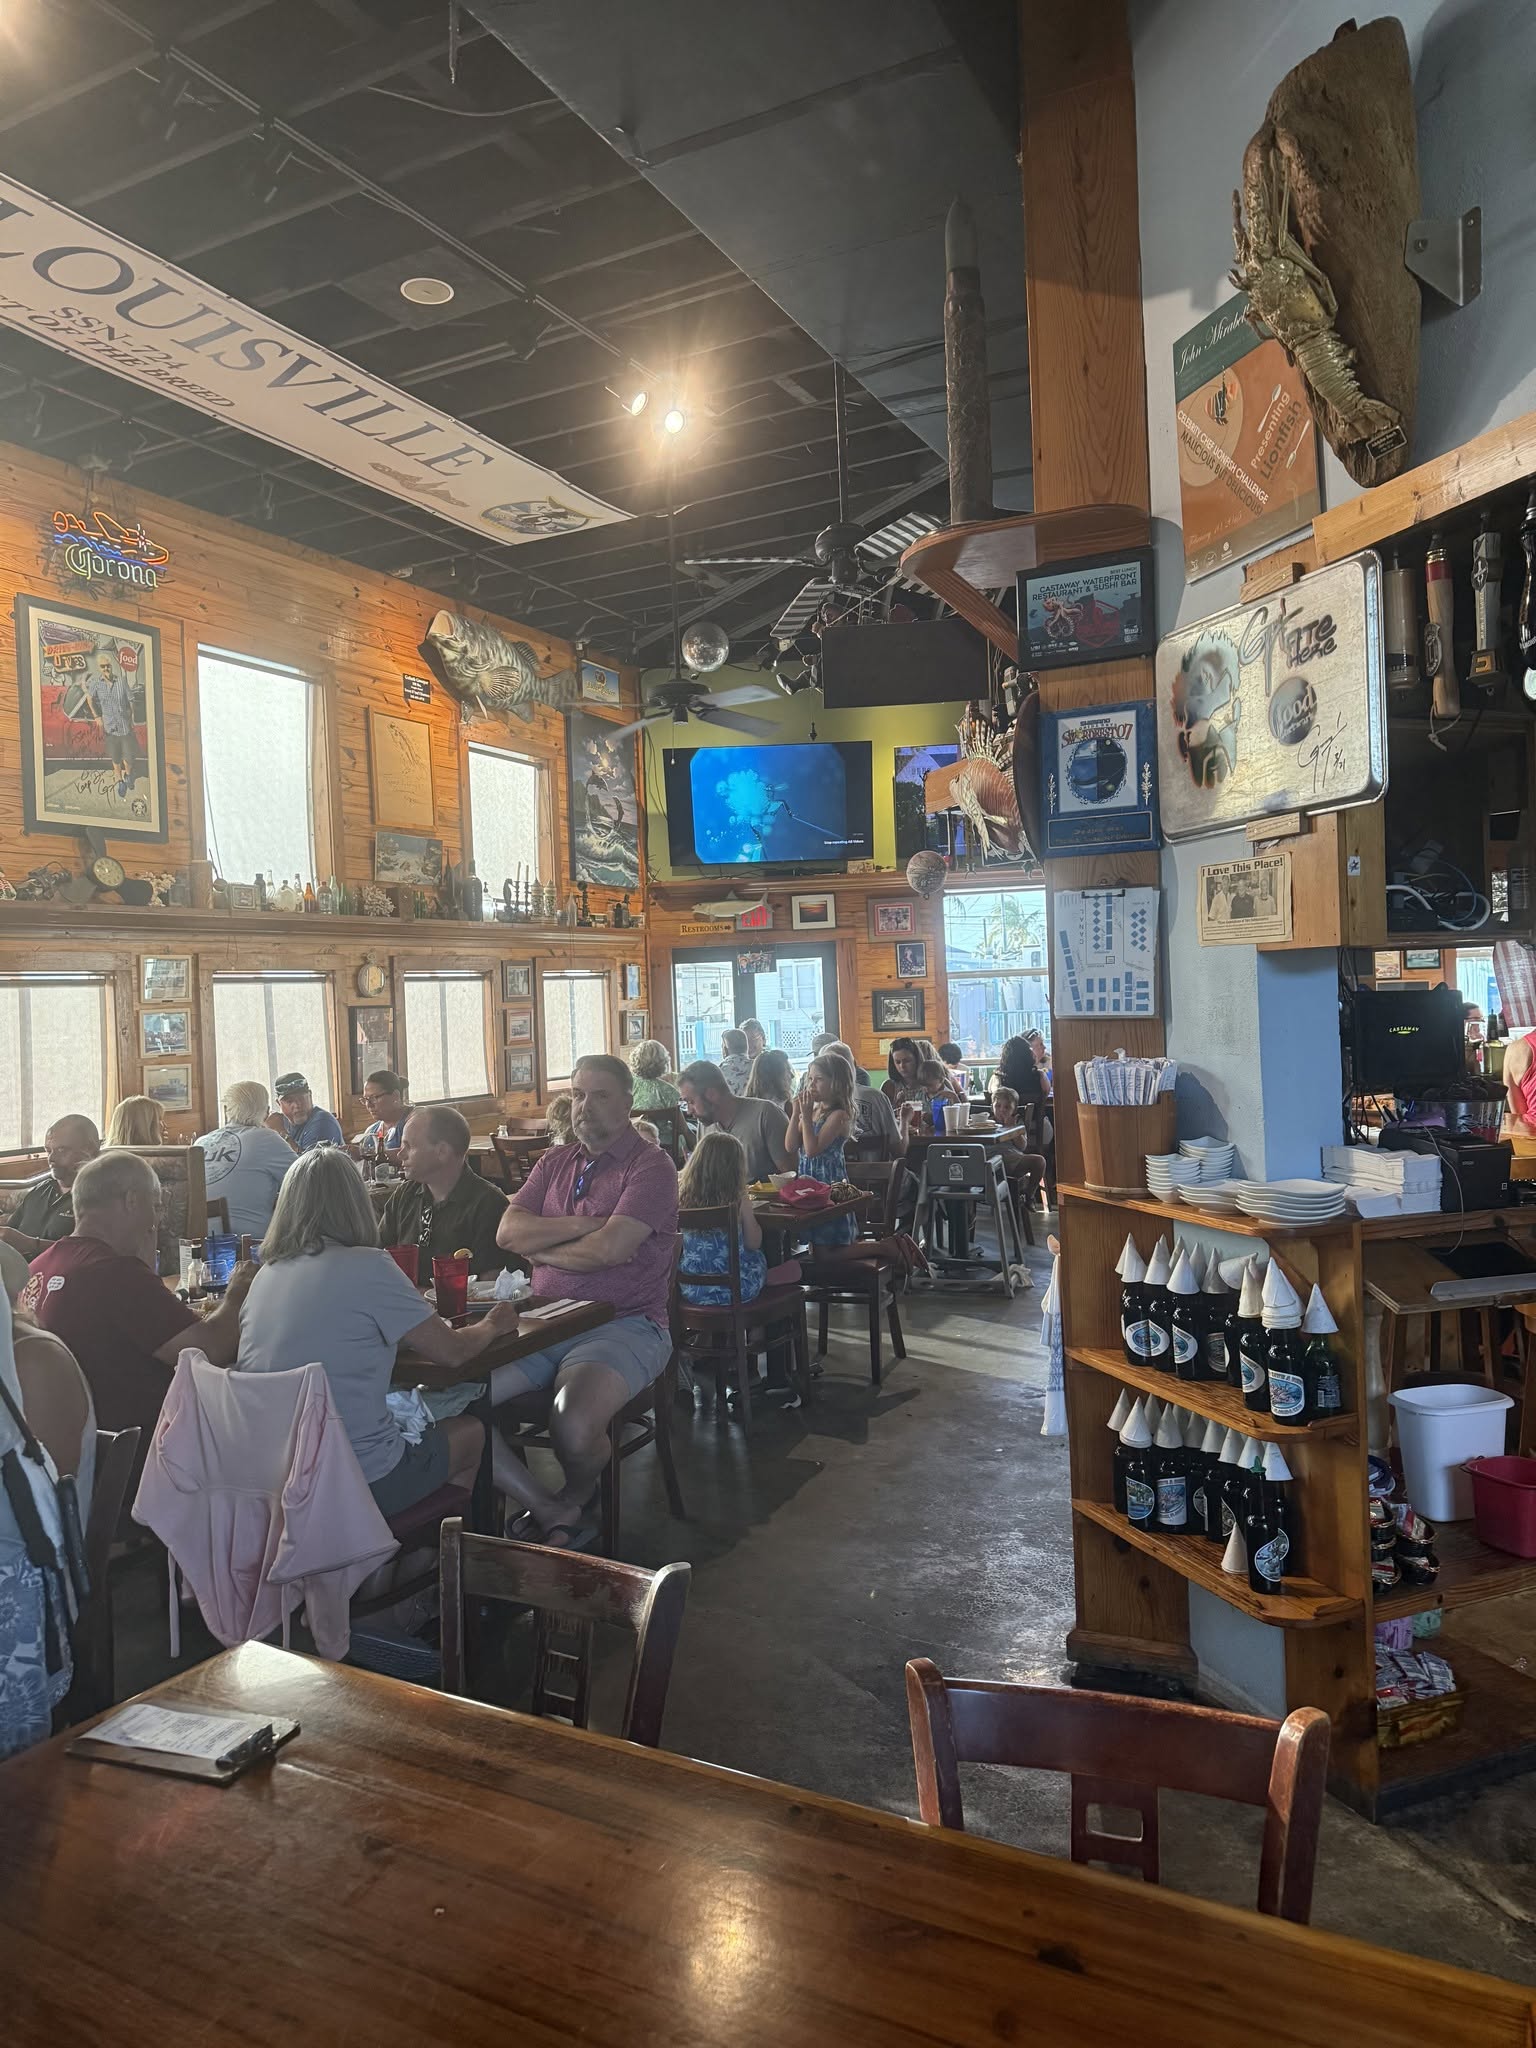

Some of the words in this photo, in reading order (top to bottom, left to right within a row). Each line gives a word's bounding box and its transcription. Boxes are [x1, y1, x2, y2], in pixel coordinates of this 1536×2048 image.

[50, 305, 190, 370] SSN-724
[27, 314, 83, 335] OF
[75, 337, 149, 367] THE
[136, 367, 236, 408] BREED
[1176, 343, 1202, 375] John
[1250, 391, 1291, 470] Presenting
[1260, 400, 1302, 480] Lionfish
[1177, 409, 1202, 438] CELEBRITY
[1200, 433, 1215, 449] CHEF
[1213, 444, 1238, 473] LIONFISH
[1235, 467, 1269, 504] CHALLENGE
[1181, 429, 1216, 469] MALICIOUS
[1214, 463, 1228, 481] BUT
[65, 543, 159, 589] Corona
[1039, 581, 1080, 593] CASTAWAY
[1082, 571, 1137, 586] WATERFRONT
[1032, 587, 1083, 601] RESTAURANT
[1093, 582, 1119, 592] SUSHI
[1120, 579, 1137, 588] BAR
[120, 651, 137, 664] food
[1207, 866, 1230, 876] Love
[1232, 862, 1251, 872] This
[1254, 857, 1283, 869] Place!
[681, 924, 724, 933] RESTROOMS
[205, 1146, 237, 1163] UK
